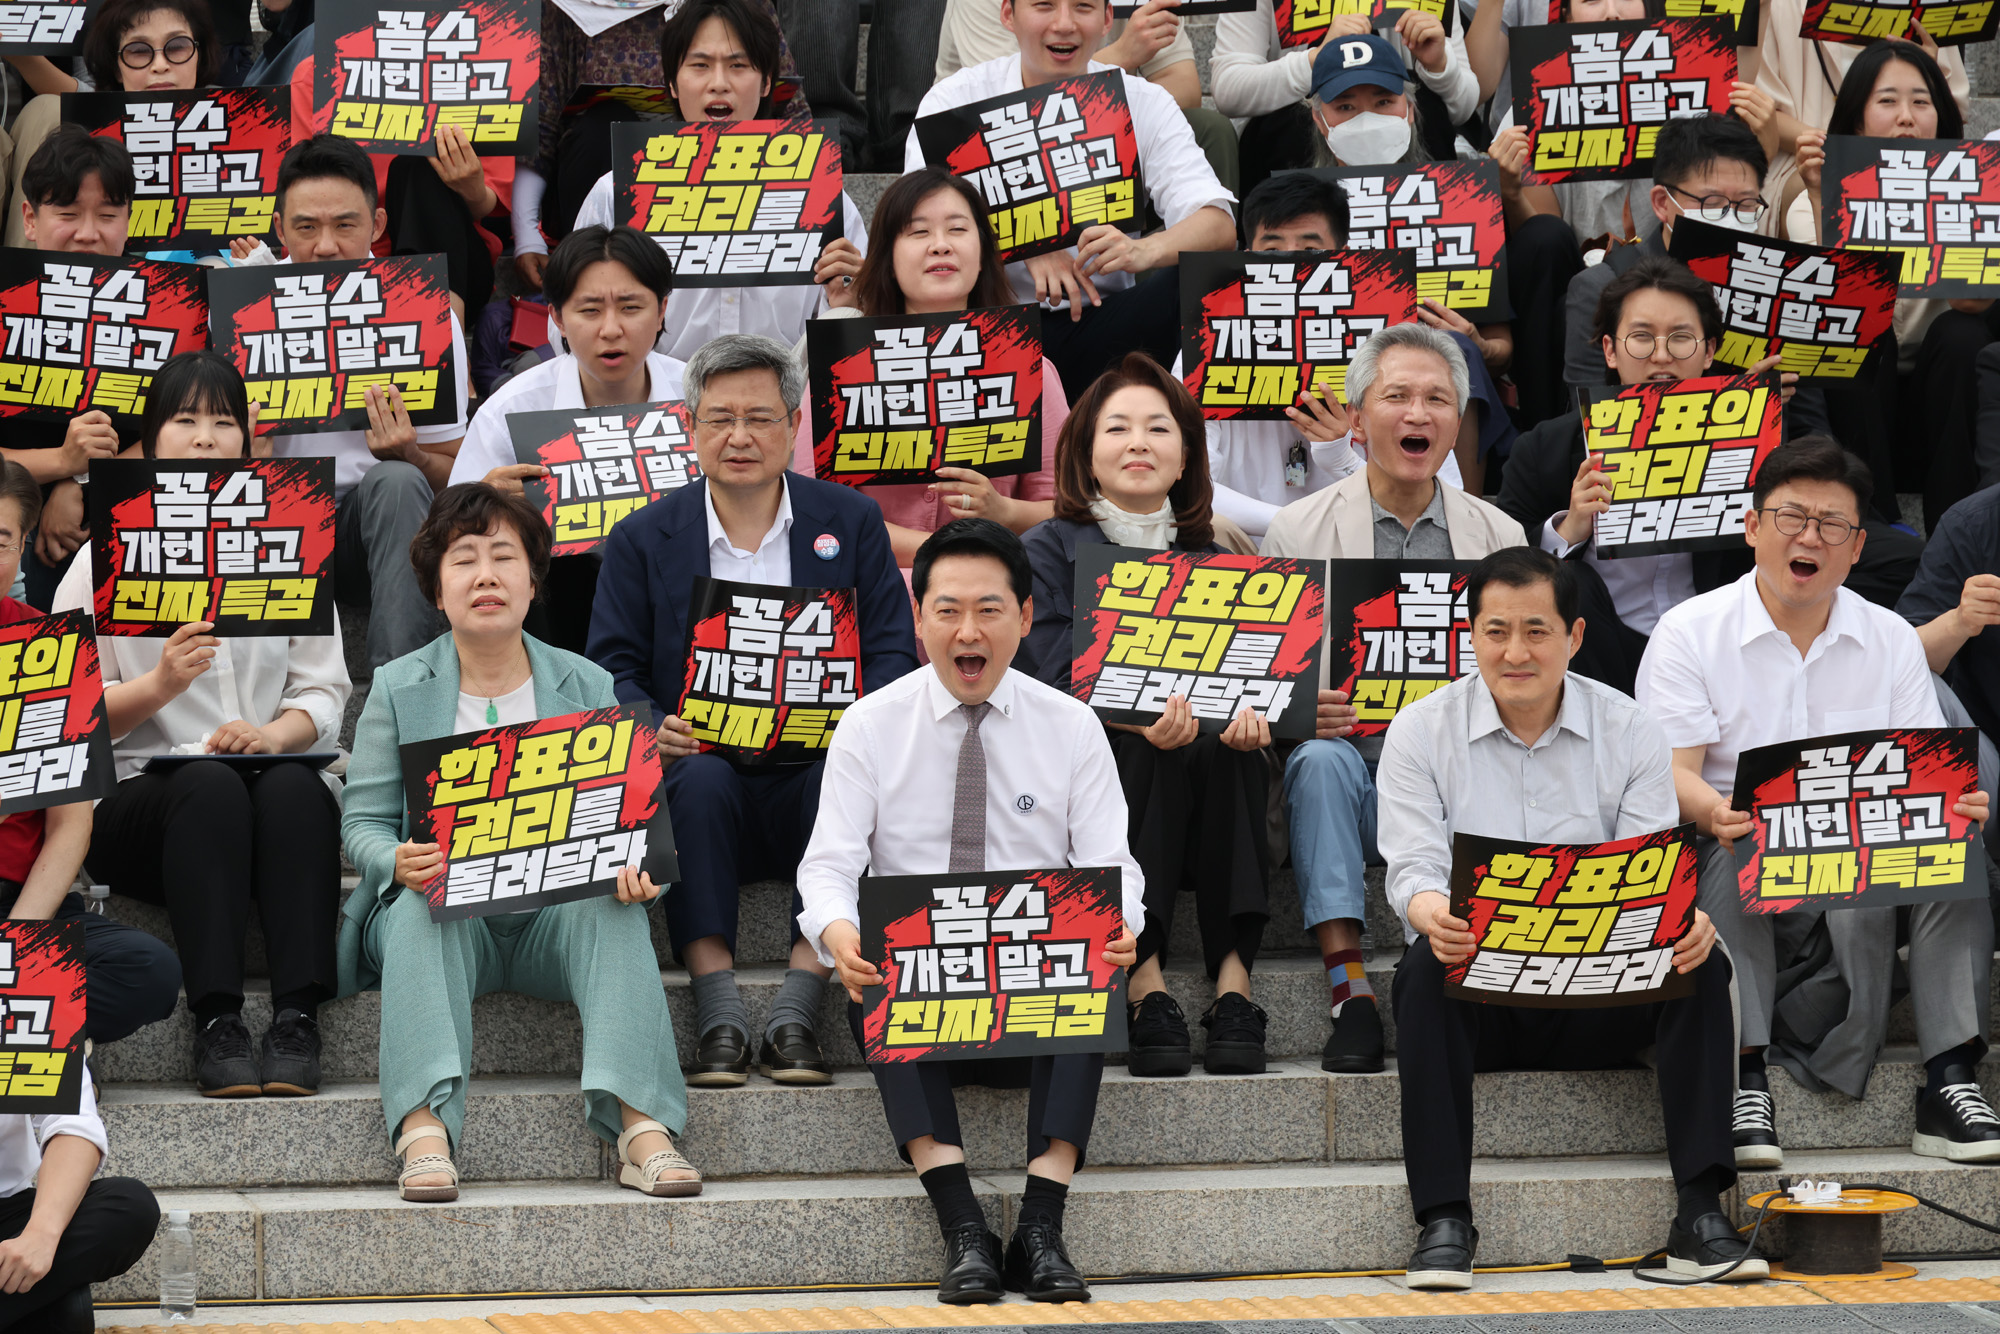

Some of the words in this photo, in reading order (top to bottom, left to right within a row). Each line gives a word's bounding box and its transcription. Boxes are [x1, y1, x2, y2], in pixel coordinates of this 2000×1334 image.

[376, 11, 478, 59] 꼼수
[1819, 3, 1911, 38] 진짜
[1921, 2, 1993, 36] 특검
[1340, 42, 1373, 68] D
[1571, 30, 1673, 83] 꼼수
[343, 60, 420, 100] 개헌
[432, 62, 508, 101] 말고
[1541, 85, 1619, 125] 개헌
[1630, 81, 1708, 121] 말고
[124, 101, 227, 152] 꼼수
[331, 102, 425, 141] 진짜
[433, 104, 524, 142] 특검
[980, 92, 1084, 162] 꼼수
[132, 156, 169, 194] 헌
[182, 153, 260, 193] 말고
[636, 135, 699, 182] 한
[703, 134, 823, 181] 표의
[962, 155, 1048, 206] 개헌
[1050, 138, 1120, 188] 말고
[1534, 128, 1625, 171] 진짜
[1879, 149, 1979, 200] 꼼수
[127, 199, 174, 237] 짜
[184, 196, 276, 235] 특검
[645, 185, 806, 232] 권리를
[1071, 179, 1133, 224] 특검
[1337, 174, 1439, 228] 꼼수
[1849, 201, 1925, 241] 개헌
[1936, 204, 2000, 242] 말고
[1397, 226, 1475, 267] 말고
[1730, 242, 1835, 301] 꼼수
[1845, 245, 1931, 284] 짜
[41, 263, 146, 322] 꼼수
[275, 271, 382, 329] 꼼수
[1245, 262, 1352, 315] 꼼수
[6, 317, 83, 363] 개헌
[94, 325, 174, 370] 말고
[1212, 320, 1292, 359] 개헌
[1779, 302, 1861, 342] 말고
[243, 331, 326, 374] 개헌
[337, 325, 420, 369] 말고
[874, 323, 981, 381] 꼼수
[1713, 331, 1768, 369] 짜
[1774, 343, 1868, 377] 특검
[0, 362, 84, 408] 진짜
[92, 372, 153, 414] 특
[244, 377, 333, 420] 진짜
[344, 370, 438, 411] 특검
[842, 383, 926, 425] 개헌
[938, 376, 1014, 422] 말고
[1202, 366, 1299, 404] 진짜
[1310, 365, 1348, 404] 특
[573, 411, 686, 459] 꼼수
[1588, 399, 1641, 450] 한
[1648, 387, 1768, 445] 표의
[835, 430, 933, 471] 진짜
[945, 420, 1030, 465] 특검
[551, 458, 640, 499] 개헌
[1603, 445, 1754, 500] 권리를
[155, 472, 266, 527] 꼼수
[121, 532, 203, 574] 개헌
[218, 531, 300, 573] 말고
[113, 580, 209, 622] 진짜
[220, 578, 317, 620] 특검
[1098, 561, 1170, 613] 한
[1172, 568, 1307, 622] 표의
[1399, 573, 1469, 627] 꼼
[729, 596, 833, 656] 꼼수
[1105, 616, 1282, 676] 권리를
[693, 650, 774, 700] 개헌
[785, 660, 854, 702] 말고
[1363, 631, 1446, 673] 개헌
[1088, 671, 1295, 722] 돌려달라
[680, 698, 775, 748] 진짜
[433, 744, 498, 806] 한
[508, 720, 634, 792] 표의
[1798, 742, 1907, 801] 꼼수
[449, 786, 623, 859] 권리를
[1762, 802, 1850, 848] 개헌
[1860, 796, 1946, 843] 말고
[446, 829, 647, 906] 돌려달라
[1476, 853, 1553, 902] 한
[1555, 841, 1682, 903] 표의
[1760, 851, 1858, 897] 진짜
[1870, 842, 1966, 888] 특검
[932, 884, 1049, 944] 꼼수
[1480, 904, 1663, 953] 권리를
[895, 947, 986, 993] 개헌
[999, 943, 1088, 990] 말고
[1462, 947, 1674, 995] 돌려달라
[0, 999, 50, 1044] 고
[886, 998, 994, 1045] 진짜
[1006, 992, 1108, 1038] 특검
